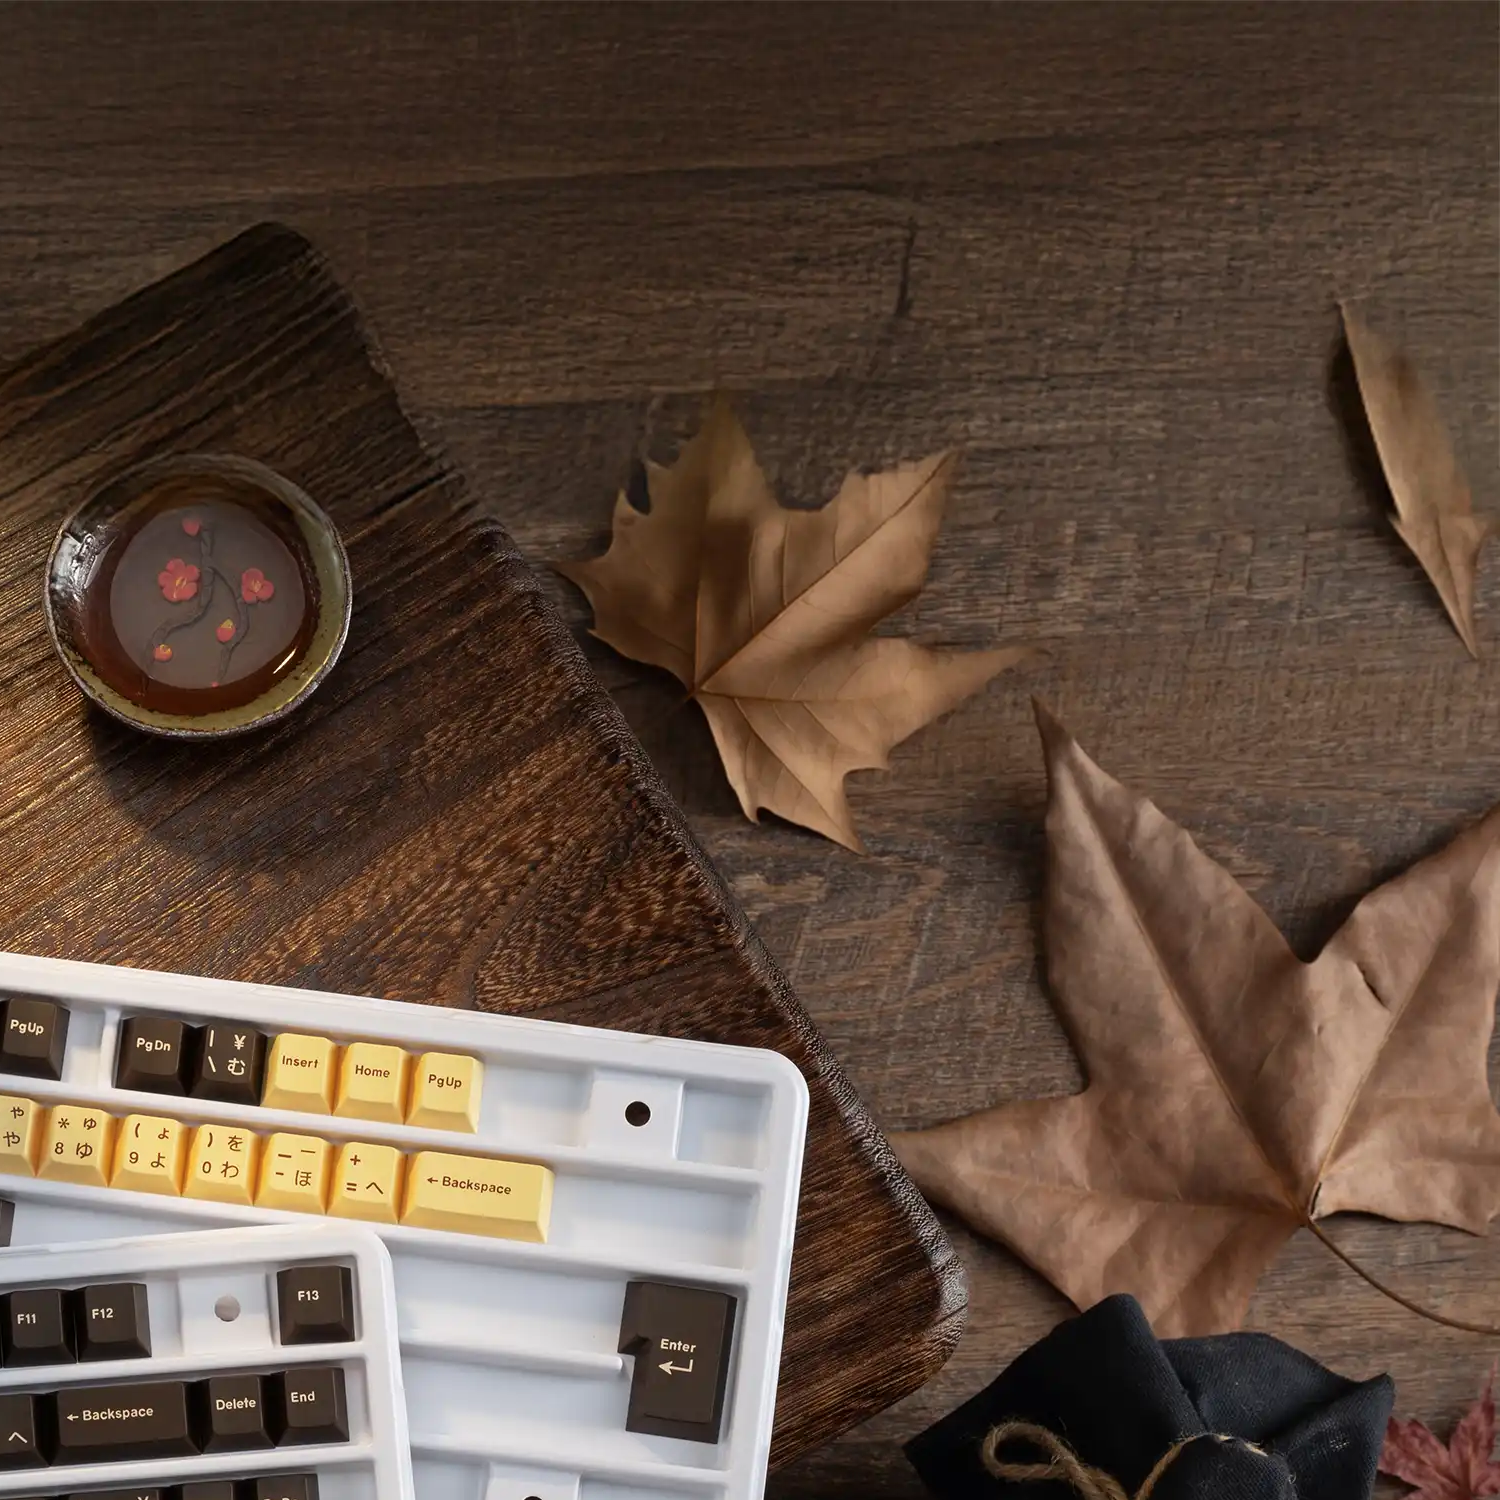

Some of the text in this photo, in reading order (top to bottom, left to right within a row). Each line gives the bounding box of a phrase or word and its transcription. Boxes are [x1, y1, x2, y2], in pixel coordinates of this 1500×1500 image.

[282, 1055, 318, 1068] Insert
[355, 1065, 390, 1078] Home
[54, 1142, 64, 1155] 8
[129, 1151, 139, 1164] 9
[442, 1176, 511, 1195] Backspace
[298, 1290, 319, 1301] F13
[17, 1314, 36, 1324] F11
[92, 1308, 113, 1319] F12
[660, 1338, 696, 1353] Enter
[291, 1391, 315, 1402] End
[216, 1397, 256, 1410] Delete
[83, 1408, 153, 1421] Backspace
